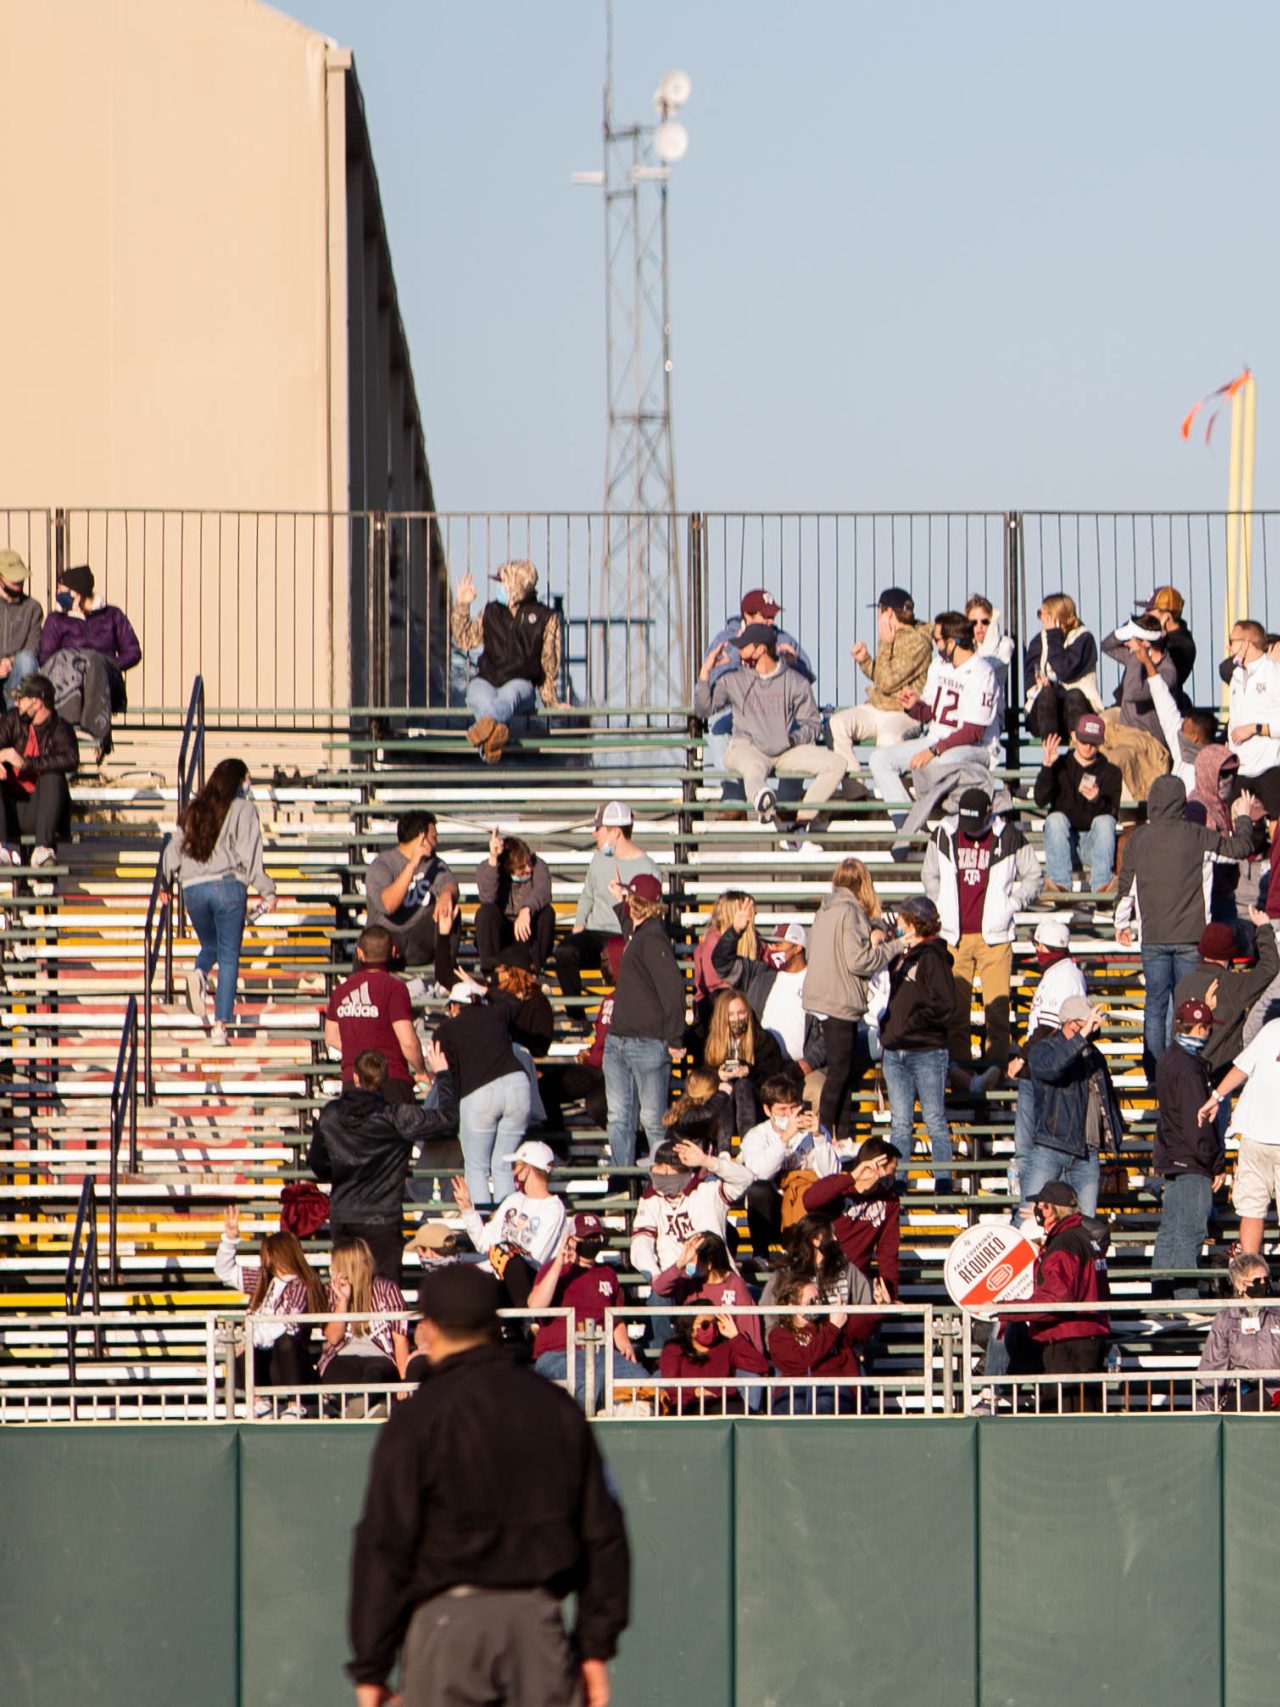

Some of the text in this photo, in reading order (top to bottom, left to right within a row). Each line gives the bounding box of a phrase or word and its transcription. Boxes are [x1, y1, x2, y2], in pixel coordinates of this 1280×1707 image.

[932, 686, 960, 728] 12
[336, 1001, 379, 1018] adidas
[958, 1236, 1006, 1285] REQUIRED
